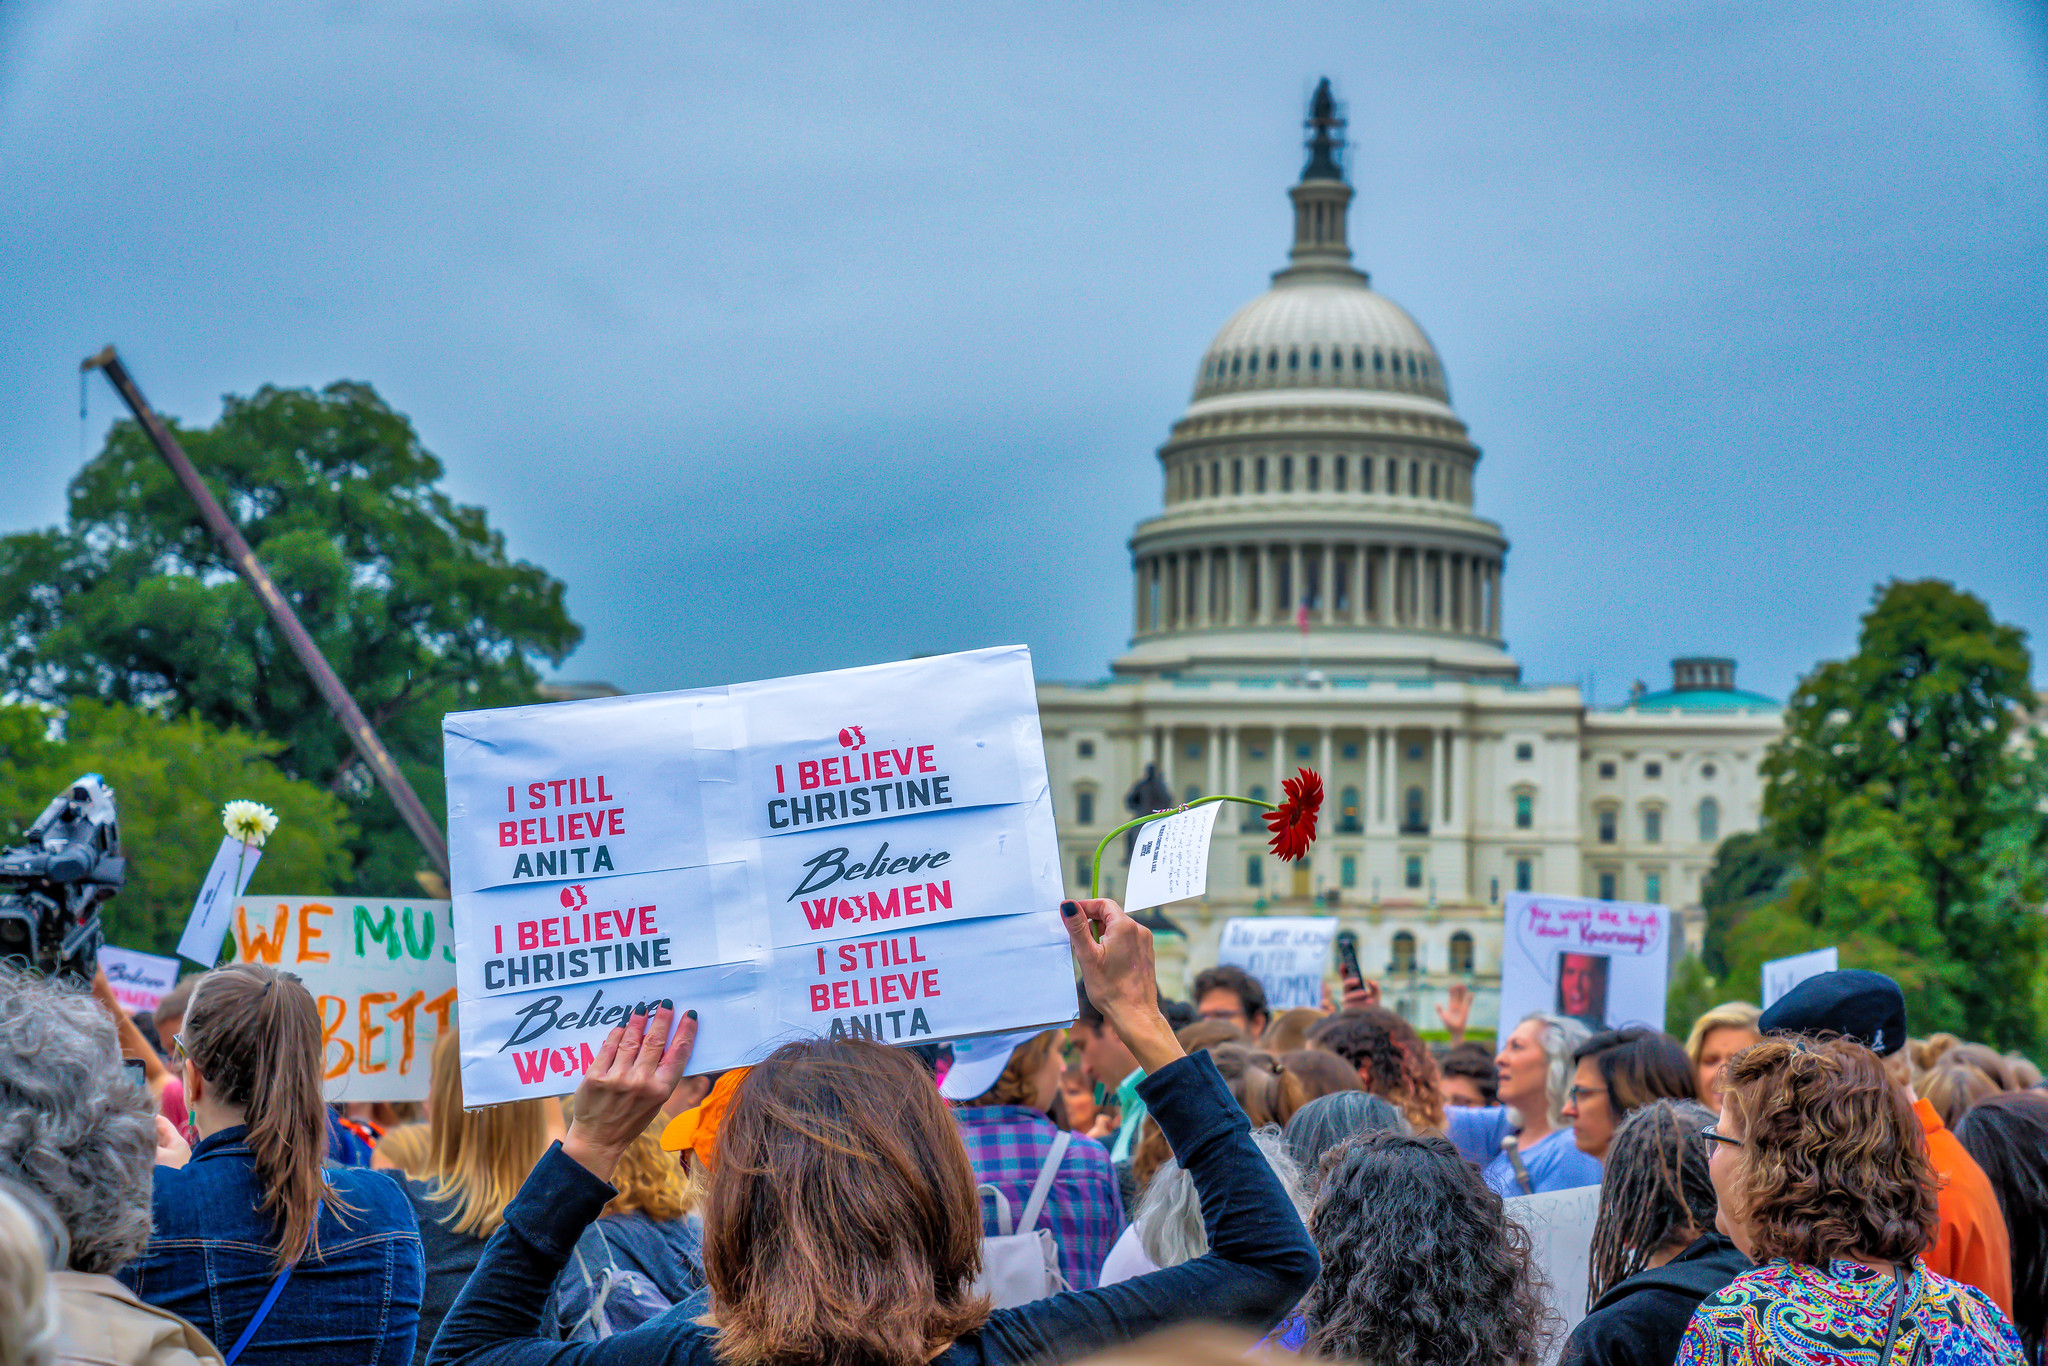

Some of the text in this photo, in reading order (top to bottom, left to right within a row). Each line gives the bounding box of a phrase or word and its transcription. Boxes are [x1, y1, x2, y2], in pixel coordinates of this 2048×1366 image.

[776, 745, 937, 793] I BELIEVE
[508, 775, 613, 812] I STILL
[768, 776, 952, 829] CHRISTINE
[499, 807, 625, 847] BELIEVE
[513, 845, 614, 879] ANITA
[787, 842, 951, 902] Believe
[800, 880, 953, 930] WOMEN
[234, 903, 333, 965] WE
[494, 905, 658, 954] I BELIEVE
[485, 938, 671, 989] CHRISTINE
[817, 936, 926, 975] I STILL
[810, 969, 941, 1012] BELIEVE
[830, 1007, 932, 1042] ANITA
